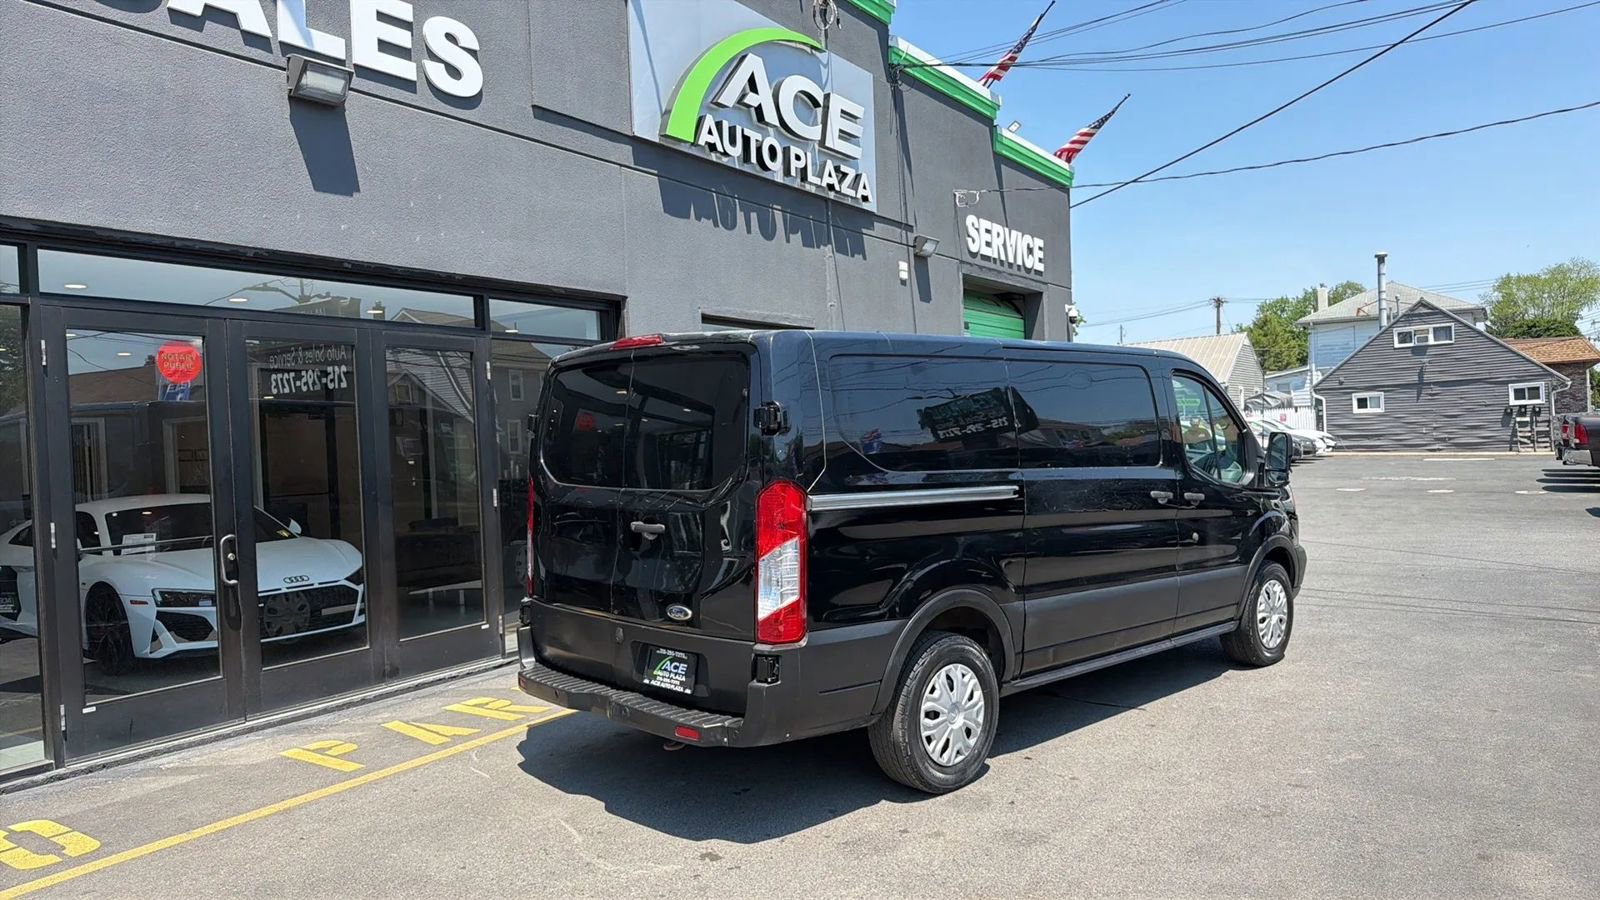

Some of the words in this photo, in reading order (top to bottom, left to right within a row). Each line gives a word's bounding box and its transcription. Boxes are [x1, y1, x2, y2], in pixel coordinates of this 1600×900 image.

[711, 52, 866, 160] ACE
[697, 114, 783, 172] AUTO
[788, 146, 872, 203] PLAZA
[965, 213, 1045, 272] SERVICE
[161, 352, 196, 361] NOTARY
[163, 360, 194, 370] PUBLIC
[661, 660, 688, 675] ACE
[670, 672, 686, 682] PLAZA
